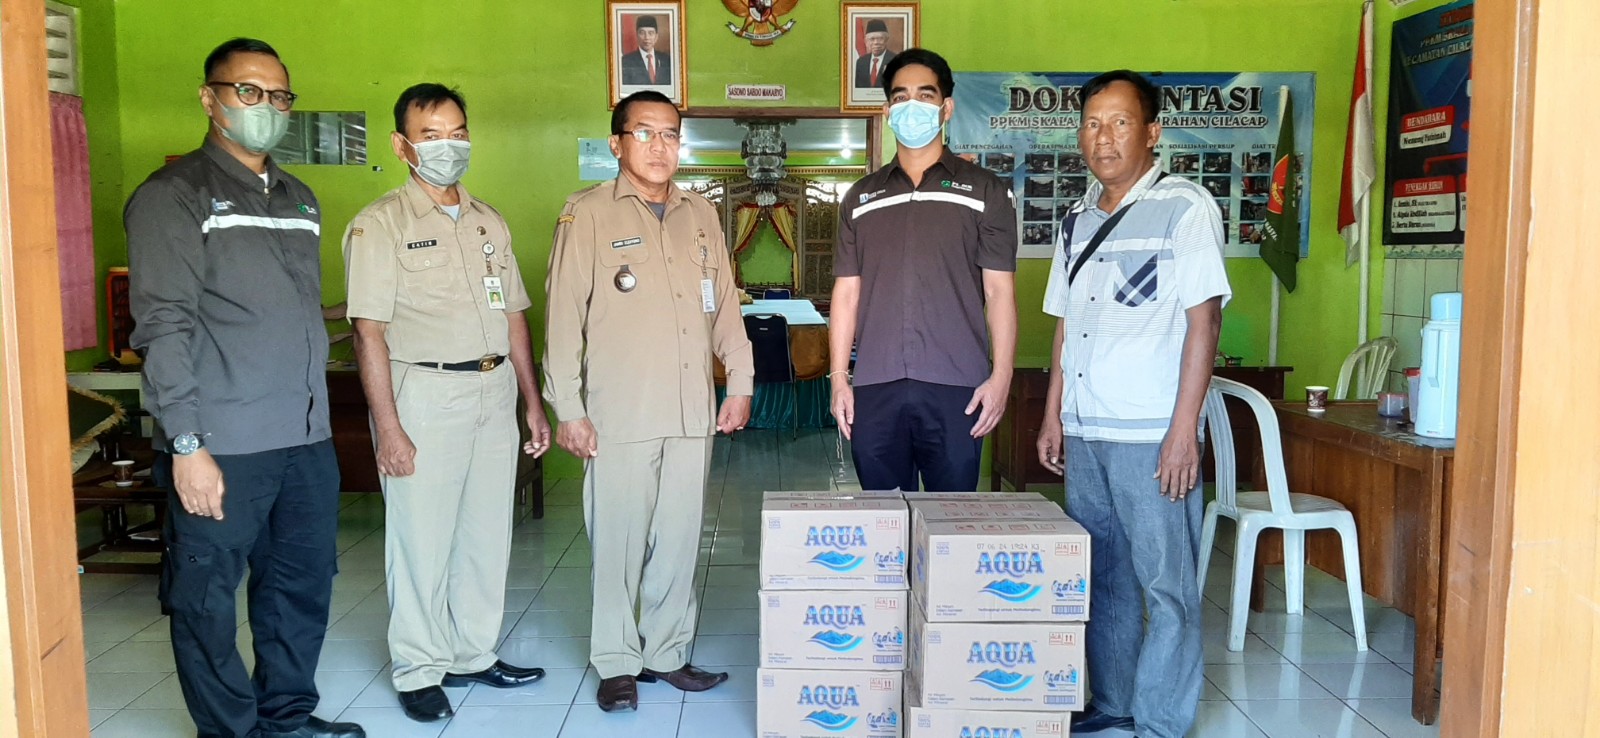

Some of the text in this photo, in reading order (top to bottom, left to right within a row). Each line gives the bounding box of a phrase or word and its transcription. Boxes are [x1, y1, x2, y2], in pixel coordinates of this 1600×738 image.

[990, 116, 1029, 128] PPKM
[1031, 116, 1077, 128] SKALA
[1211, 115, 1268, 127] CILACAP
[804, 525, 868, 551] AQUA
[975, 551, 1045, 578] AQUA
[802, 604, 866, 630] AQUA
[966, 641, 1036, 668] AQUA
[797, 684, 860, 710] AQUA
